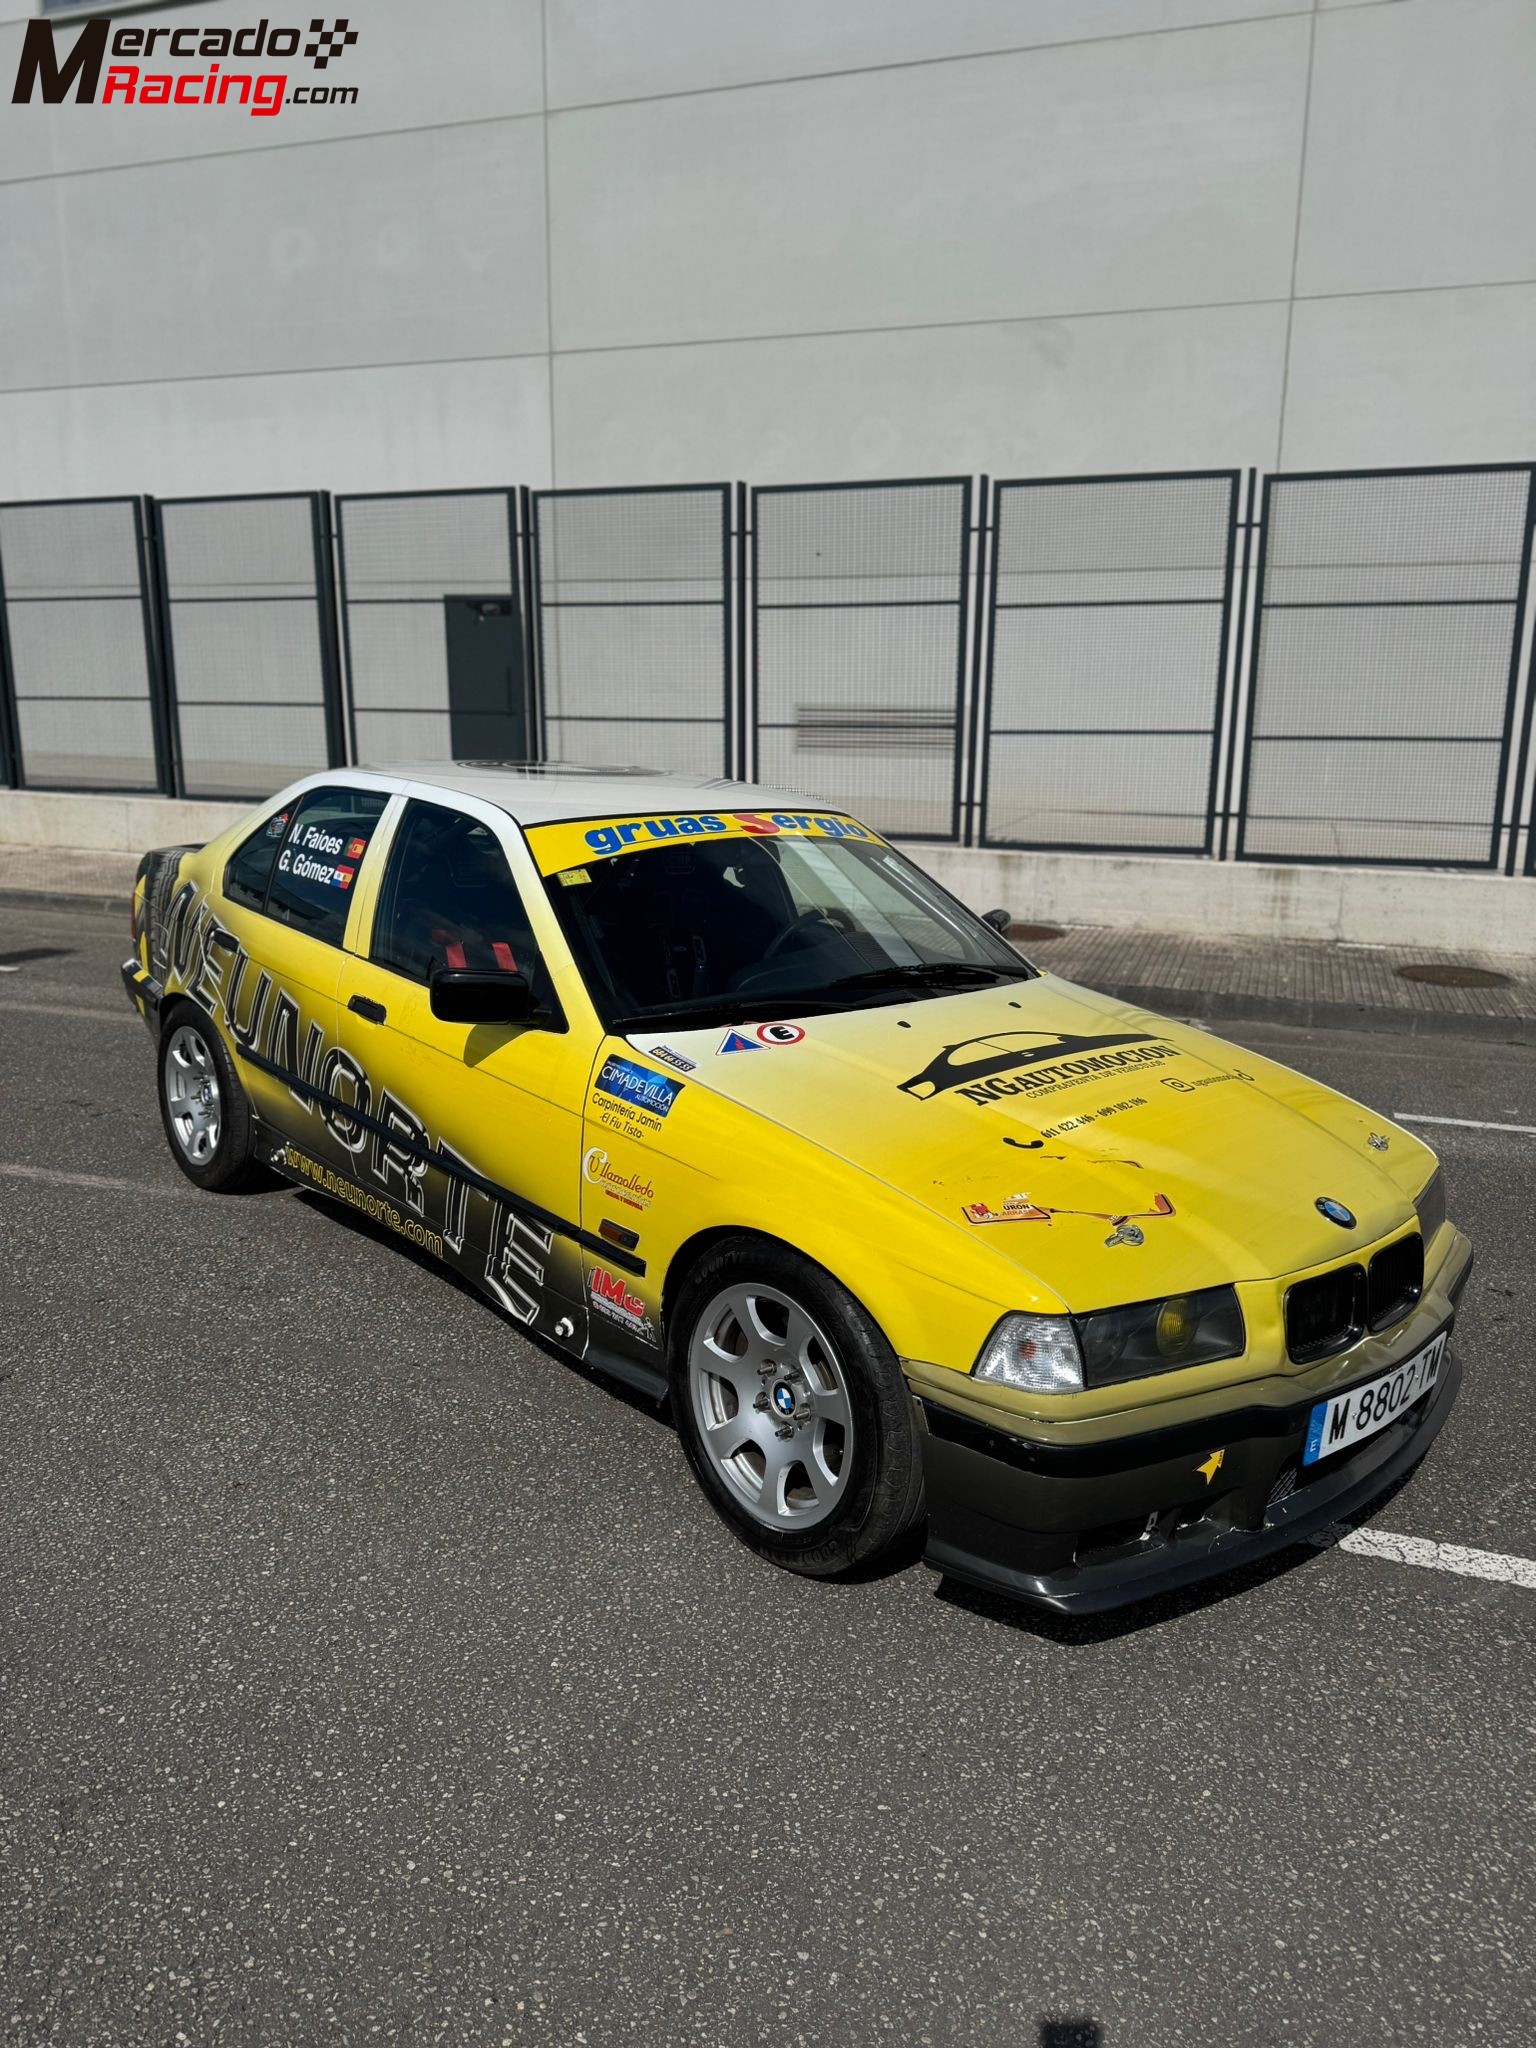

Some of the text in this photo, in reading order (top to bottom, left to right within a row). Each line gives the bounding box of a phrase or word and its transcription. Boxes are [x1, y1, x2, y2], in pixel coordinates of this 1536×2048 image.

[288, 823, 304, 845] N.
[584, 812, 870, 855] gruas Sergio
[278, 849, 335, 885] G. Gómez
[601, 1066, 673, 1106] CIMADEVILLA
[955, 1045, 1181, 1106] NGAUTOMOCION
[1026, 1074, 1102, 1099] COMPRAVENTA
[1099, 1070, 1116, 1078] DE
[155, 879, 553, 1327] NEUNORTE
[592, 1093, 662, 1132] Carpintería Jamín
[285, 1145, 443, 1258] www.neunorte.com
[1328, 1340, 1444, 1445] M 8802 TM
